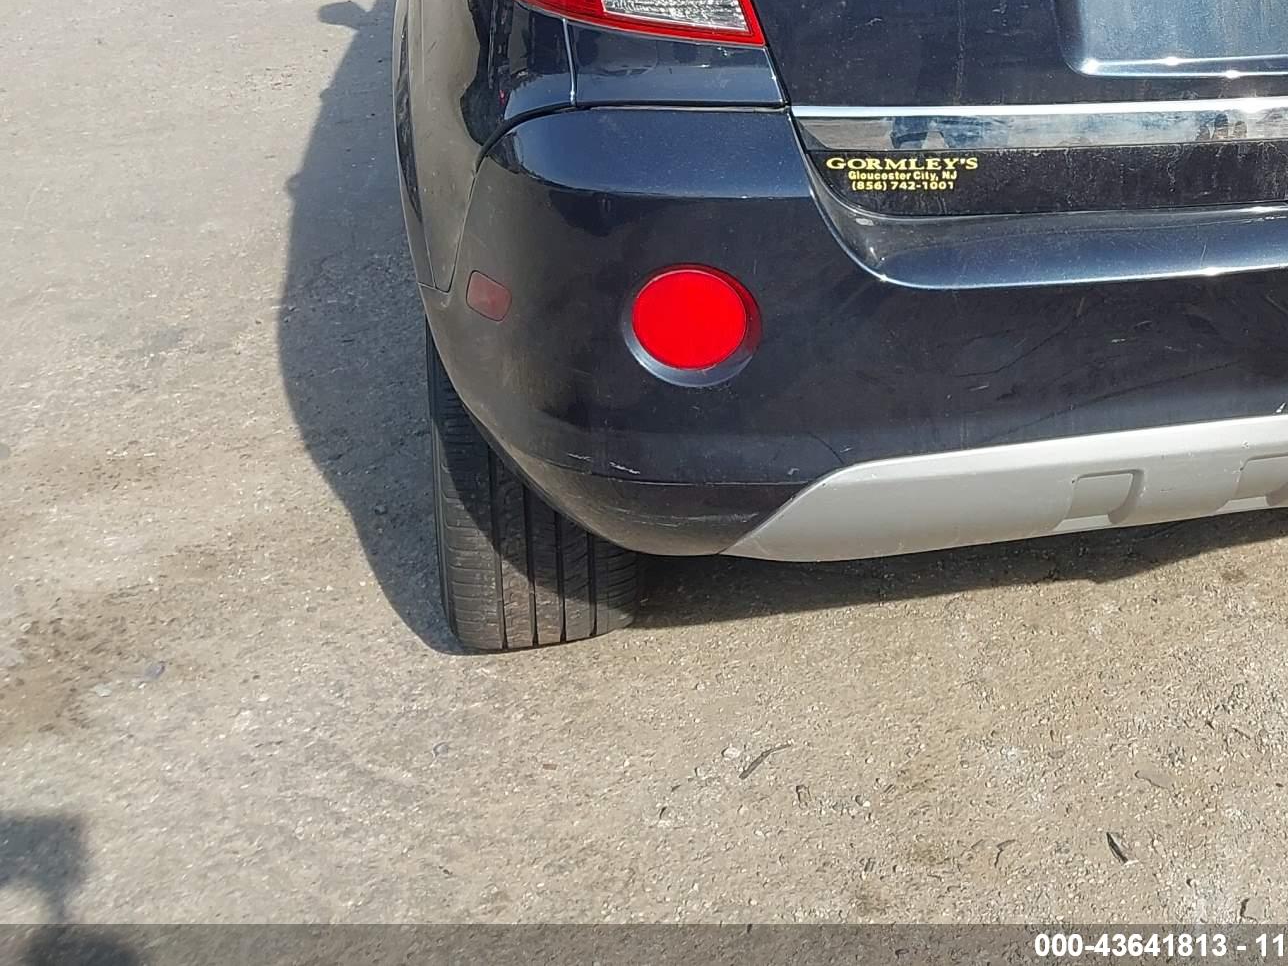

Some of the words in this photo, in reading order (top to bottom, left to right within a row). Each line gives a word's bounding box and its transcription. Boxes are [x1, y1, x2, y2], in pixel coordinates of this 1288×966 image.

[826, 158, 978, 170] GORMLEY'S
[849, 171, 912, 180] Gloucester
[914, 171, 939, 181] City,
[943, 171, 958, 180] NJ
[852, 181, 887, 191] (856)
[891, 181, 954, 190] 742-1001
